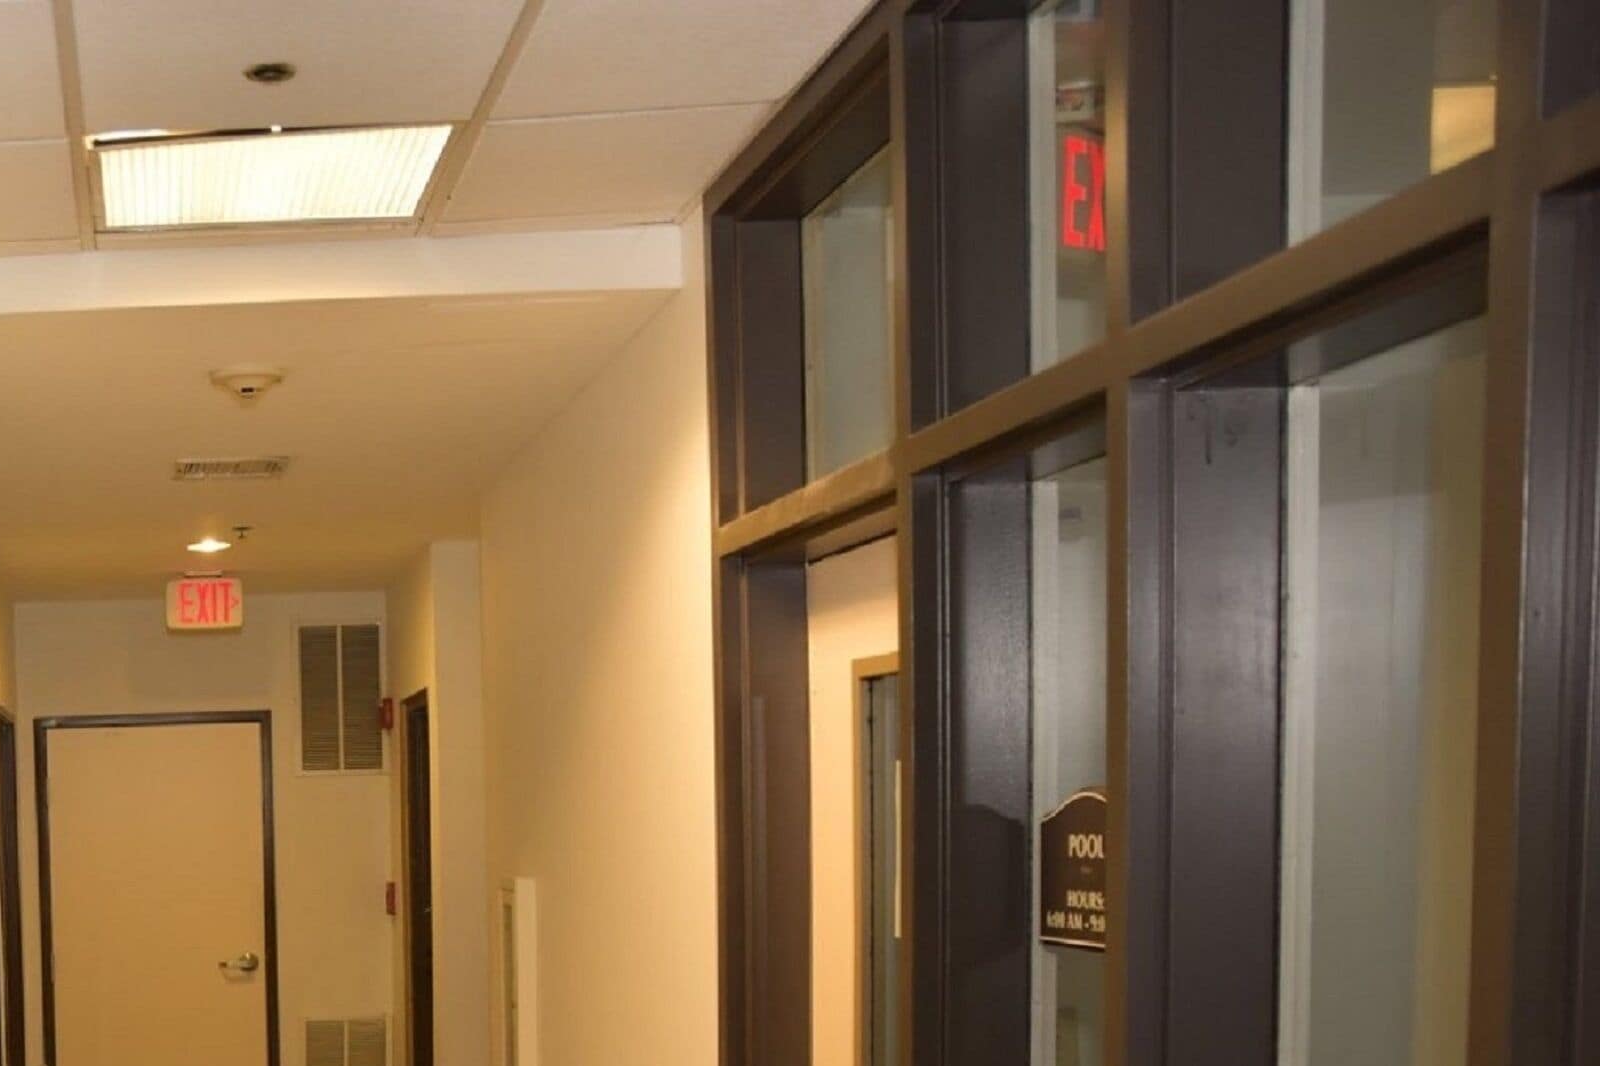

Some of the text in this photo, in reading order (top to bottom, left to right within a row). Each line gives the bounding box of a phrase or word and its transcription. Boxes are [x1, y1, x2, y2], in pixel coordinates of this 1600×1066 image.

[1063, 133, 1106, 251] EX
[179, 582, 232, 624] EXIT
[1068, 833, 1104, 859] POOL
